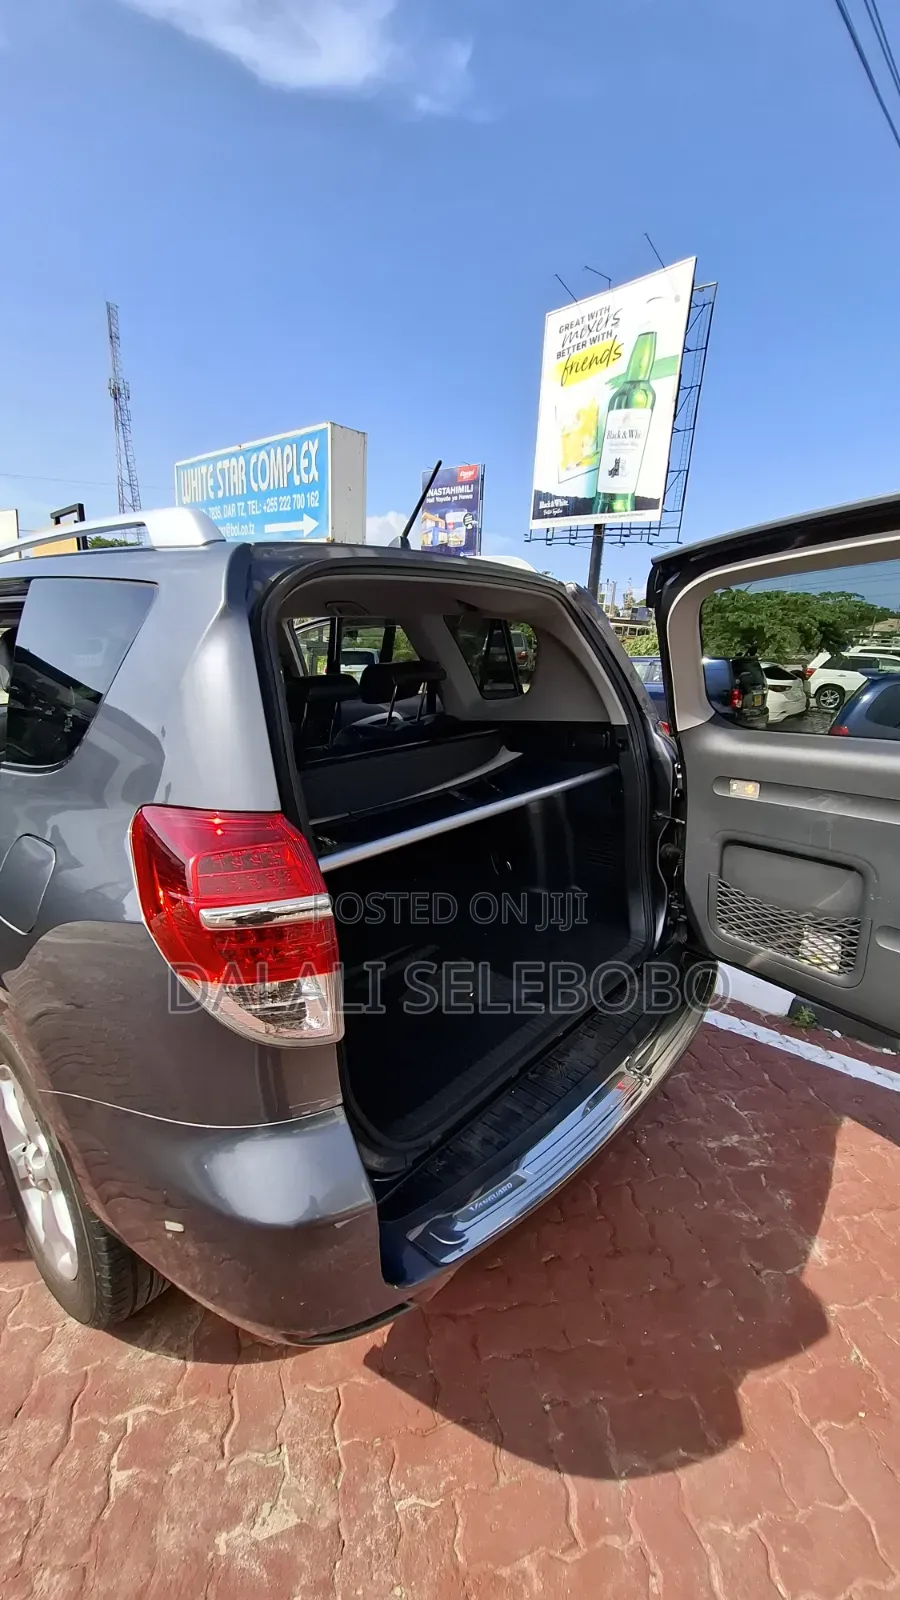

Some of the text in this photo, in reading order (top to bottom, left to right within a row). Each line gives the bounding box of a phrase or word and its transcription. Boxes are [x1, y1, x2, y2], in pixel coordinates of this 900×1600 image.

[559, 305, 610, 334] GREAT WITH
[557, 329, 612, 360] BETTER WITH
[561, 335, 624, 387] friends
[621, 430, 627, 439] &
[181, 438, 319, 504] WHITE STAR COMPLEX
[223, 501, 236, 518] DAR
[247, 500, 262, 516] TEL:
[263, 497, 278, 514] +255
[279, 495, 291, 512] 222
[292, 493, 306, 510] 700
[306, 491, 319, 507] 162
[468, 1182, 514, 1212] VANGUARD
